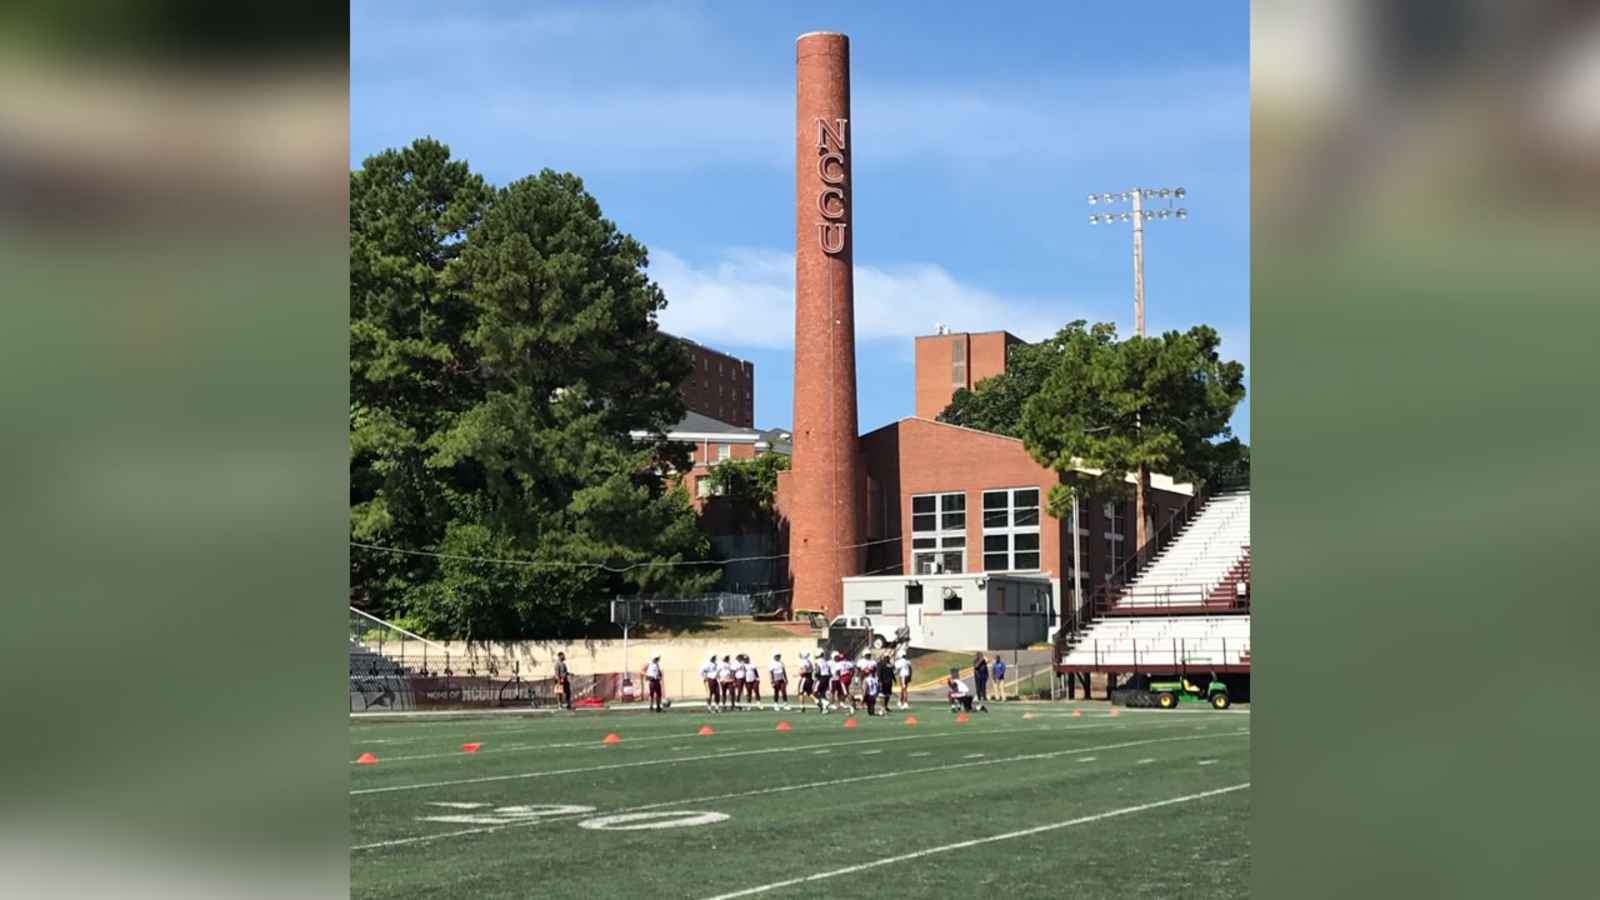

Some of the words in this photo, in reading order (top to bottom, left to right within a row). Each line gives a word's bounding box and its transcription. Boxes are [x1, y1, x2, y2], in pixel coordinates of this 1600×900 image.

[814, 116, 848, 254] NCCU
[427, 691, 448, 700] HOME
[449, 690, 460, 700] OF
[461, 686, 494, 701] NCCU
